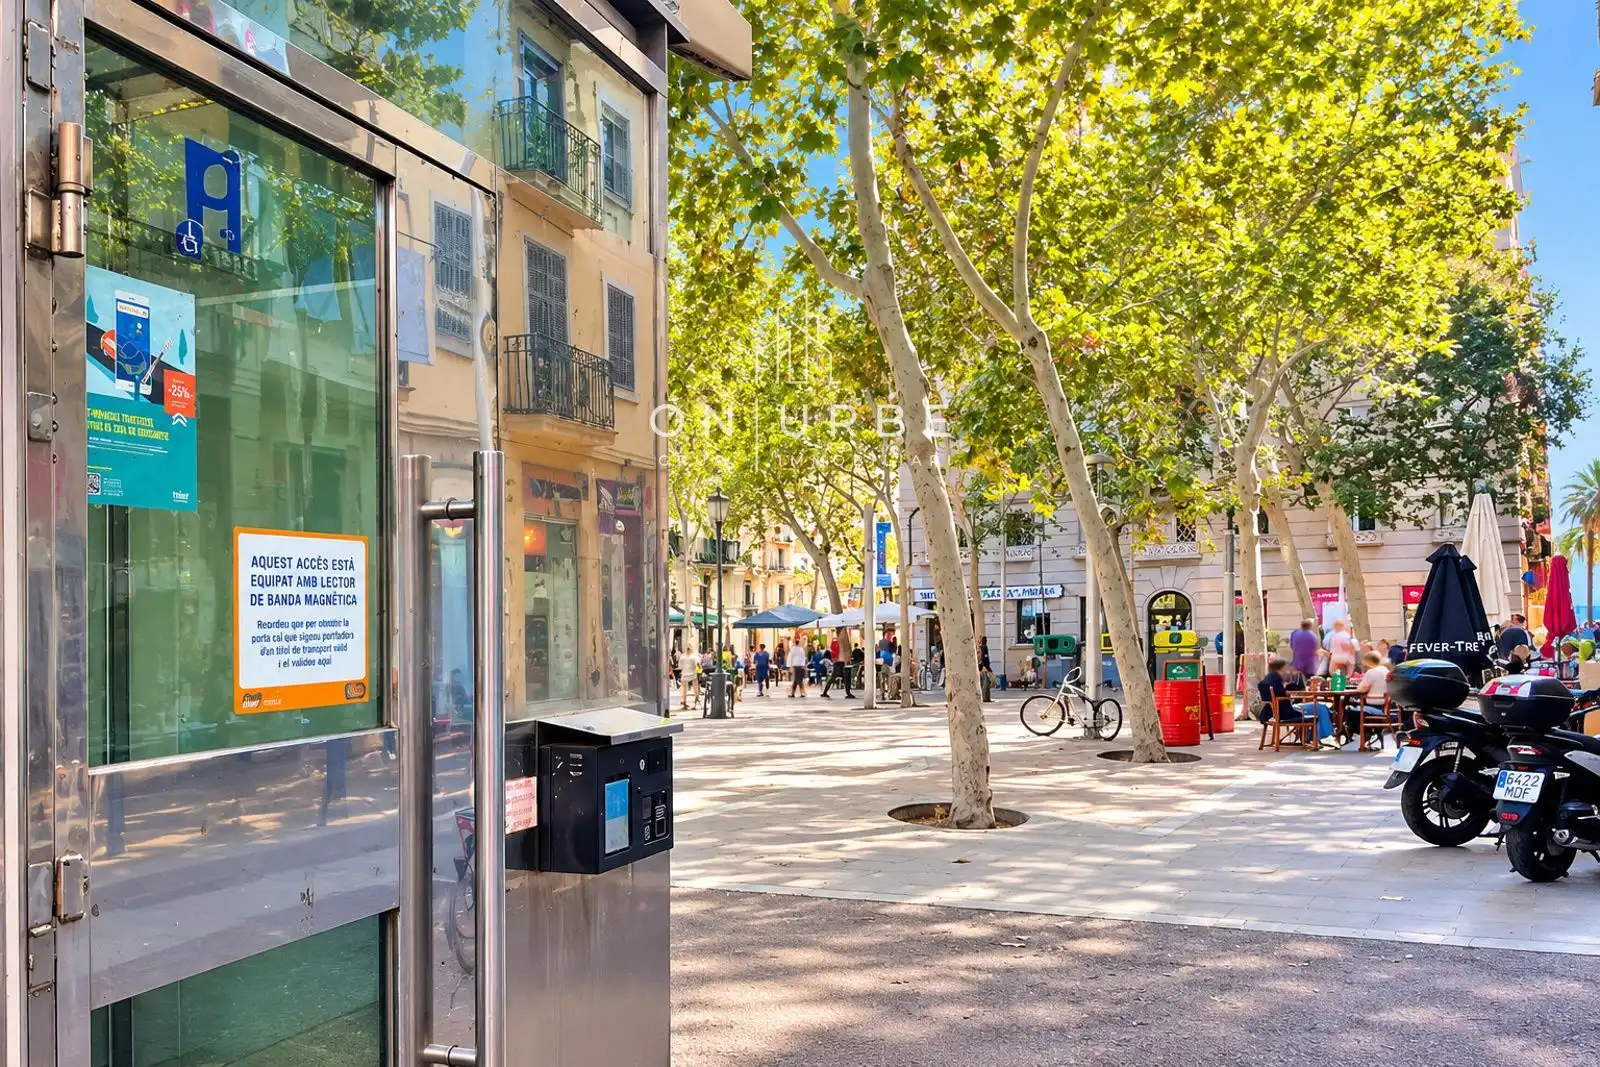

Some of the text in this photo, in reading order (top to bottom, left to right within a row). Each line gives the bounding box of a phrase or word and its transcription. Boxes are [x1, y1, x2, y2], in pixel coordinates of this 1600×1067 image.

[251, 556, 293, 570] AQUEST
[251, 575, 355, 588] EQUIPAT AMB LECTOR
[250, 594, 264, 606] DE
[267, 594, 301, 606] BANDA
[251, 634, 271, 644] porta
[272, 632, 283, 642] cal
[292, 645, 301, 654] de
[1507, 773, 1540, 787] 6422
[1504, 787, 1531, 799] MDF
